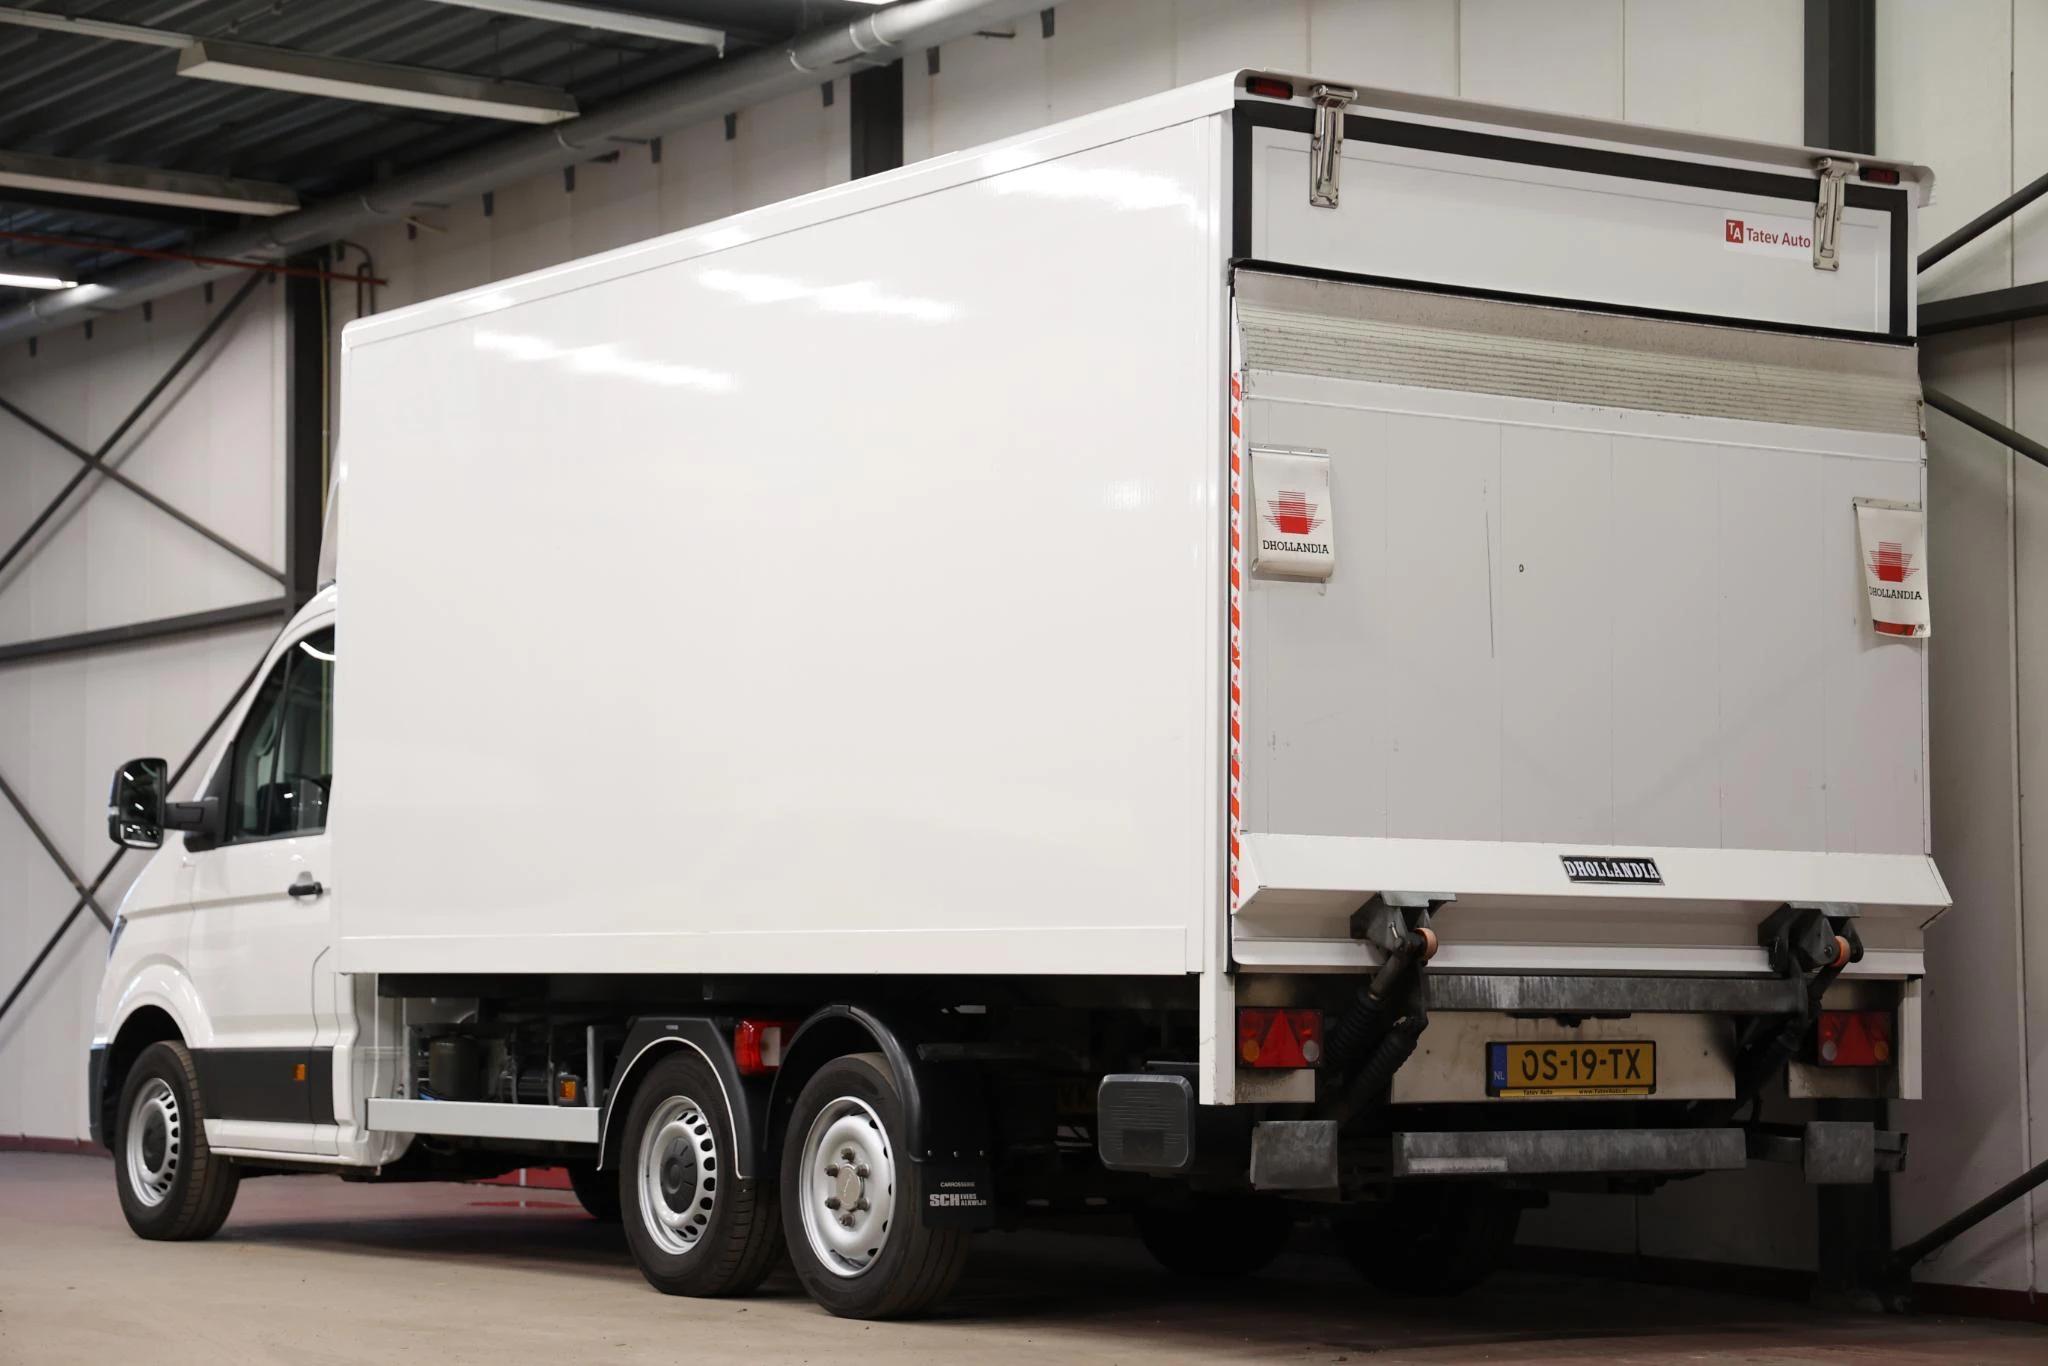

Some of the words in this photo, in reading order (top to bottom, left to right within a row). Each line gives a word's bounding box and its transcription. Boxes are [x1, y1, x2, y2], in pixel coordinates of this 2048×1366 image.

[1746, 227, 1779, 245] Tatev
[1781, 232, 1811, 248] Auto
[1262, 539, 1330, 555] DHOLLANDIA
[1563, 860, 1661, 879] DHOLLANDIA
[1521, 1048, 1641, 1081] OS-19-TX
[1493, 1071, 1505, 1081] NL
